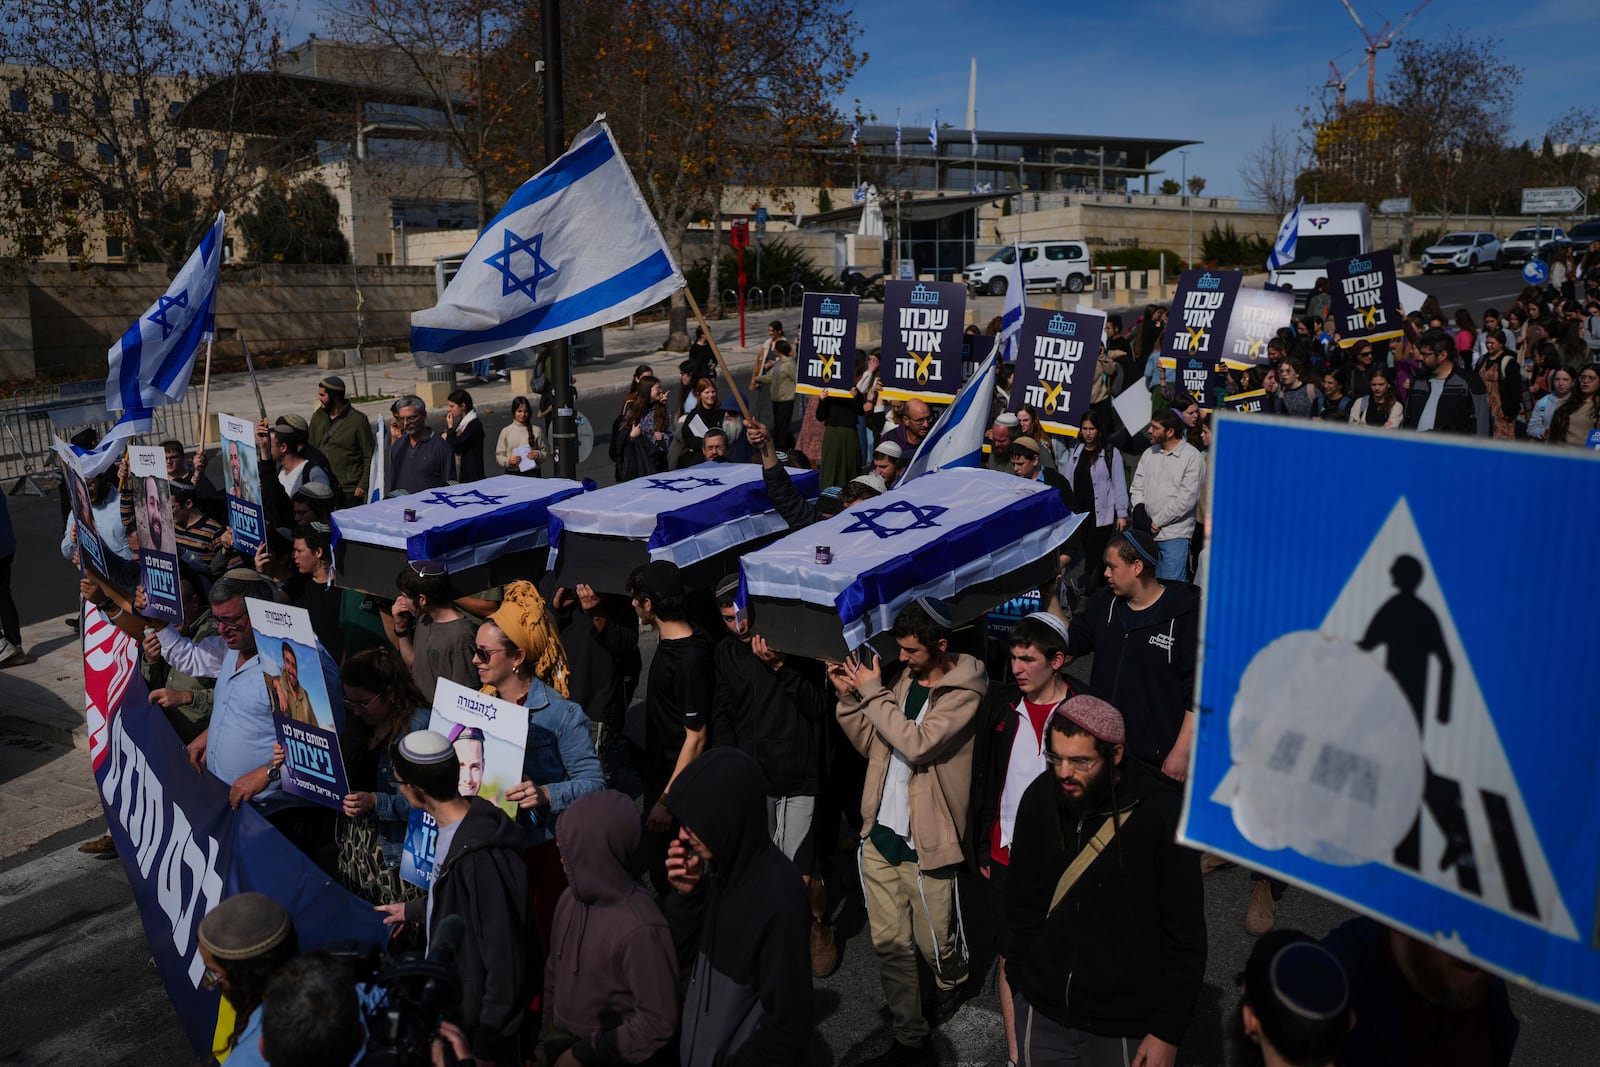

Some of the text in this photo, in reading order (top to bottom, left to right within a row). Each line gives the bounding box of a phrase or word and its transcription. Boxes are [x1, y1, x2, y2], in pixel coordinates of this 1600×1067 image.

[1341, 271, 1384, 294] שכחו
[911, 291, 939, 302] תקווה
[1184, 291, 1224, 309] שכחו
[1346, 288, 1382, 309] אותי
[899, 307, 949, 330] שכחו
[1183, 310, 1215, 328] אותי
[1242, 305, 1280, 322] שכחו
[812, 317, 847, 336] שכחו
[1048, 319, 1076, 333] תקווה
[1241, 321, 1272, 338] אותי
[812, 336, 842, 355] אותי
[900, 330, 942, 352] אותי
[1034, 335, 1084, 362] שכחו
[1034, 358, 1075, 384] אותי
[1183, 369, 1208, 380] שכחו
[1184, 380, 1205, 391] אותי
[147, 566, 176, 595] ניצחון
[457, 695, 485, 713] הגבורה
[282, 724, 292, 736] לנו
[305, 732, 330, 749] במותם
[285, 737, 334, 775] ניצחון
